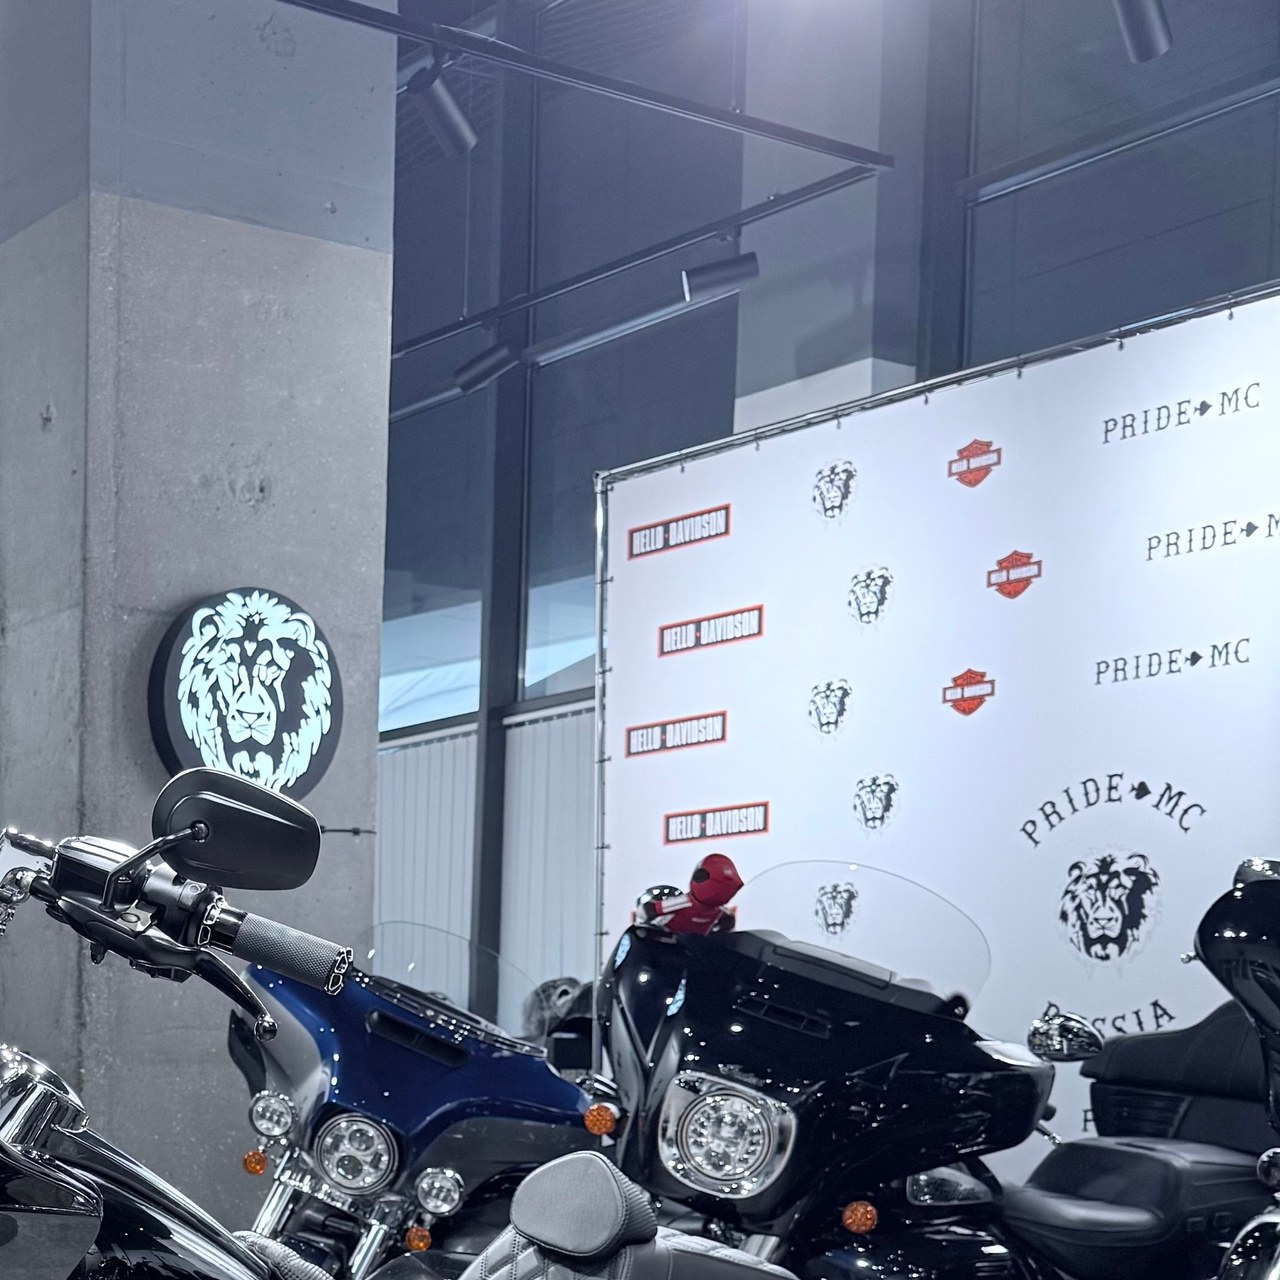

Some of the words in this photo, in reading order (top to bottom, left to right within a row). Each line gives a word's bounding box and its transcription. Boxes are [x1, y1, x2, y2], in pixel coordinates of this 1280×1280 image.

[1102, 398, 1192, 444] PRIDE
[1218, 382, 1261, 416] MC
[632, 525, 664, 555] HELLO
[669, 508, 726, 546] DAVIDSON
[1145, 519, 1237, 561] PRIDE
[1265, 513, 1280, 538] M
[663, 623, 696, 653] HELLO
[700, 609, 760, 645] DAVIDSON
[1094, 647, 1183, 686] PRIDE
[1208, 637, 1250, 668] MC
[630, 726, 662, 754] HELLO
[666, 715, 724, 748] DAVIDSON
[668, 814, 701, 841] HELLO
[705, 805, 765, 836] DAVIDSON
[1020, 771, 1124, 849] PRIDE
[1151, 781, 1208, 834] MC
[1042, 999, 1176, 1040] RSSIA
